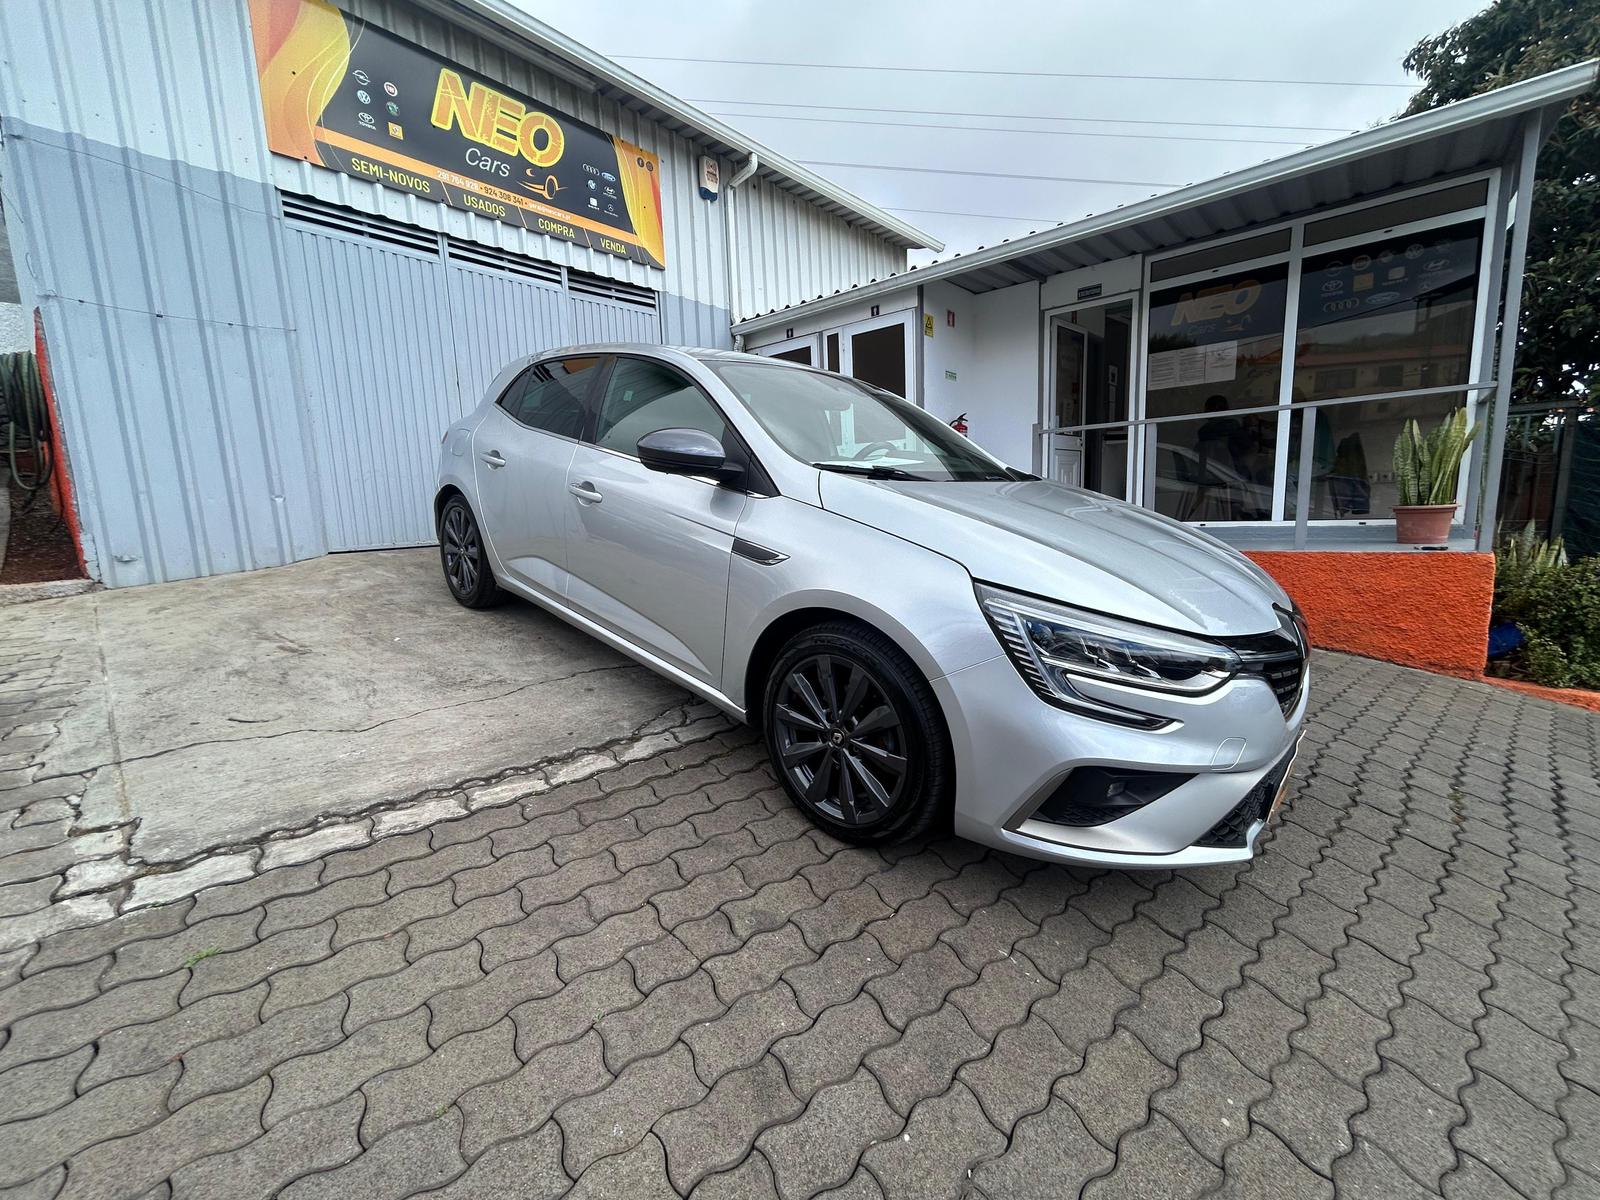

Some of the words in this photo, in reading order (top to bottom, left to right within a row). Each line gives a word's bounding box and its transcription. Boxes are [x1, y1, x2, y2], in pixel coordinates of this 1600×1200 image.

[431, 67, 565, 167] NEO
[465, 148, 510, 177] Cars
[351, 158, 431, 193] SEMI-NOVOS
[463, 194, 506, 217] USADOS
[538, 218, 575, 239] COMPRA
[600, 237, 627, 255] VENDA
[484, 187, 498, 197] 924
[512, 196, 524, 206] 341
[1172, 279, 1262, 326] NEO
